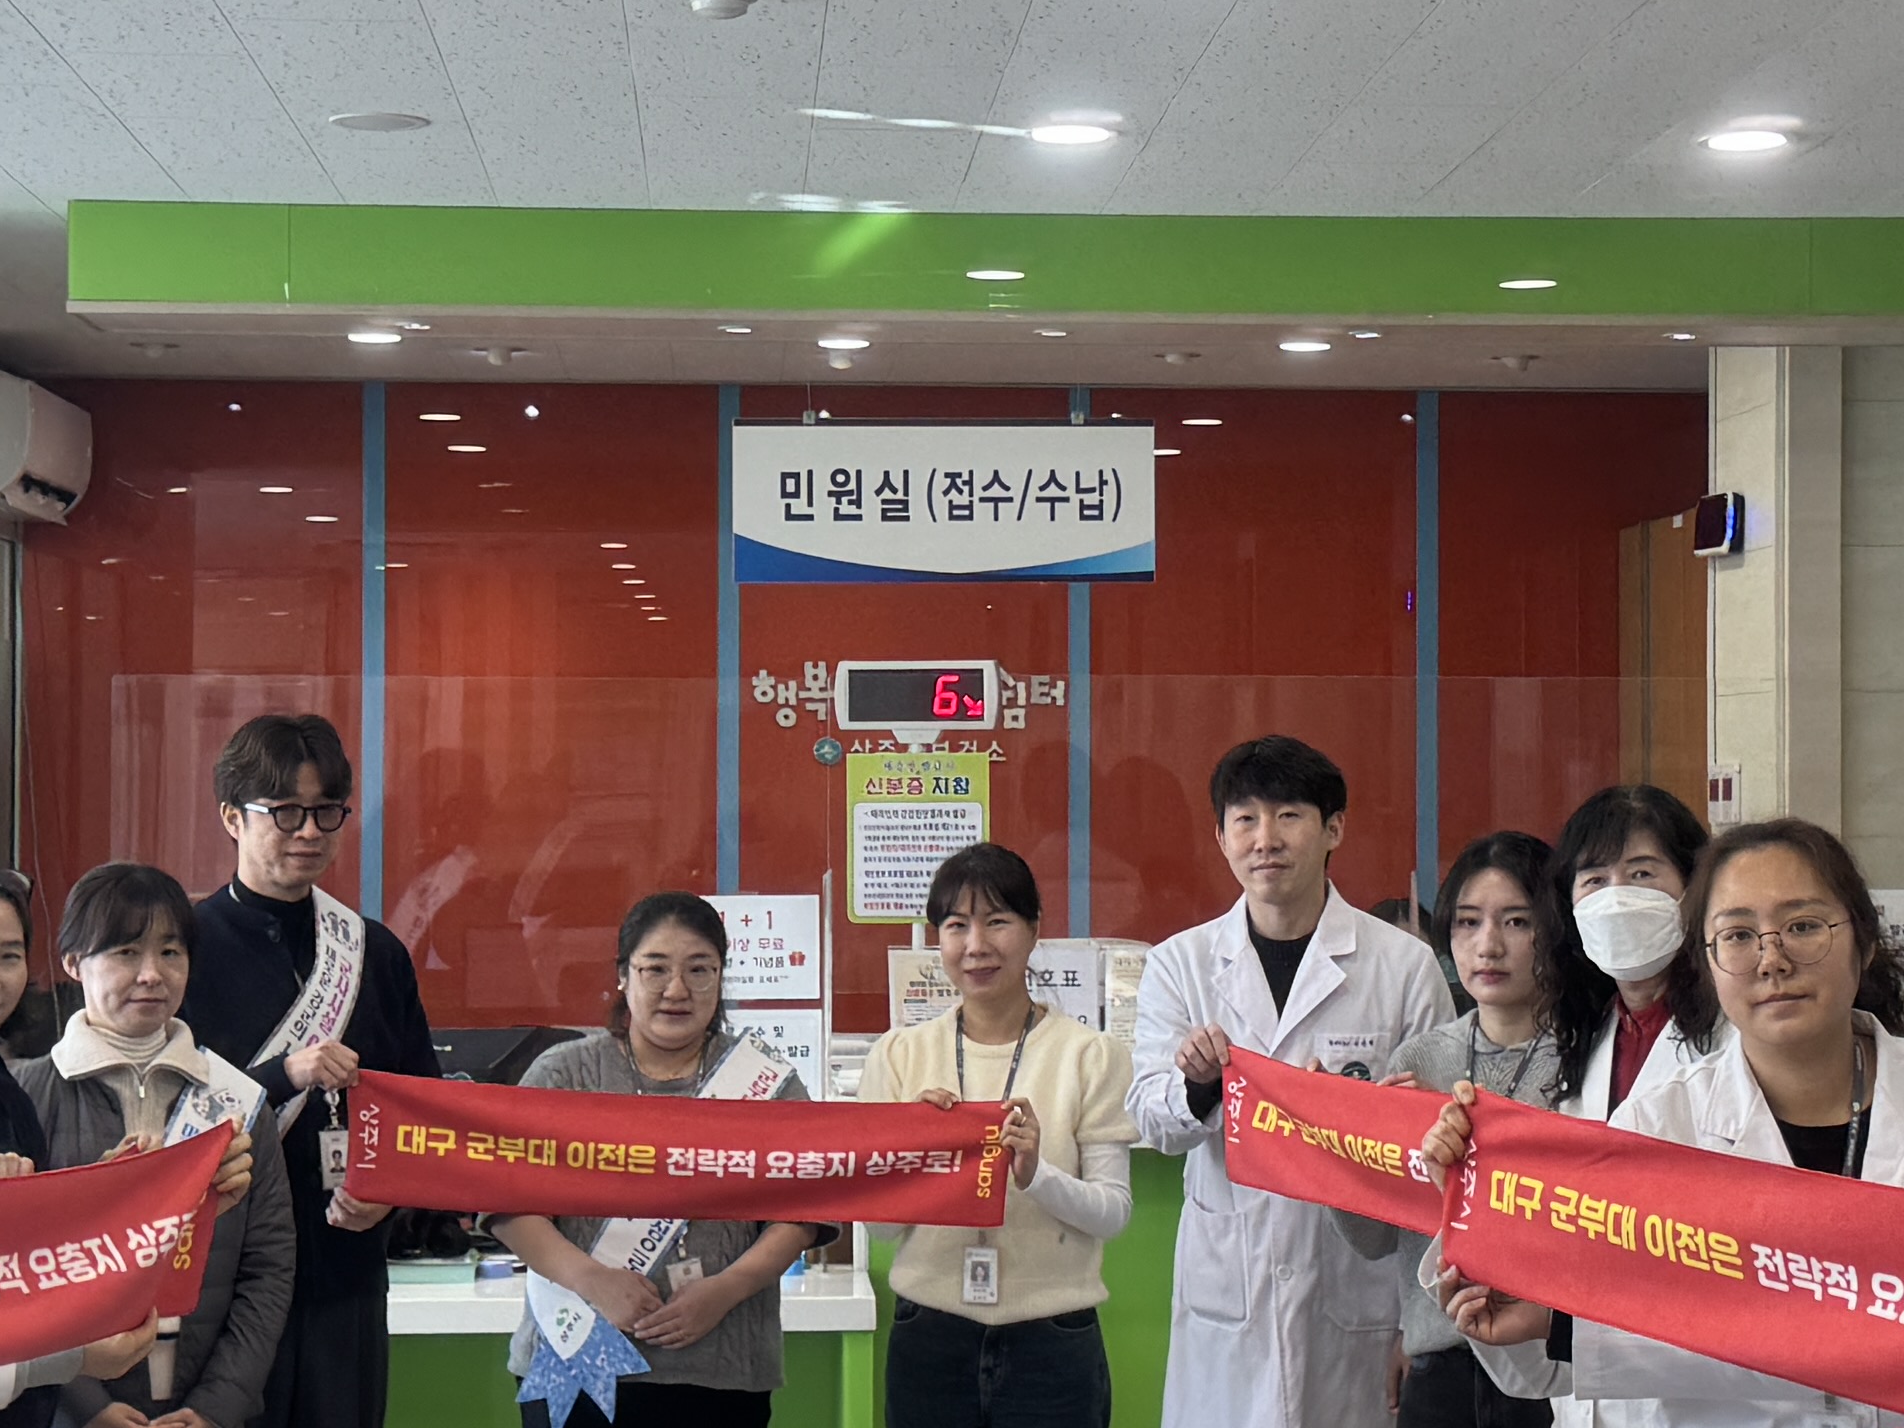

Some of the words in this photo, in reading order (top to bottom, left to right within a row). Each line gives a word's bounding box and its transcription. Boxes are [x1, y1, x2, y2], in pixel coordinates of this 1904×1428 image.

[778, 467, 912, 523] 민원실
[925, 467, 1123, 523] (접수/수납)
[356, 1103, 381, 1170] 상주시
[396, 1124, 457, 1157] 대구
[465, 1132, 557, 1168] 군부대
[566, 1140, 657, 1174] 이전은
[666, 1146, 756, 1180] 전략적
[765, 1151, 855, 1180] 요충지
[865, 1149, 962, 1177] 상주로!
[976, 1125, 999, 1199] sangju
[1251, 1099, 1296, 1138] 대구
[1343, 1133, 1406, 1179] 이전은
[29, 1233, 128, 1291] 요충지
[1489, 1168, 1544, 1222] 대구
[1549, 1184, 1637, 1248] 군부대
[1644, 1213, 1745, 1281] 이전은
[1750, 1242, 1859, 1312] 전략적
